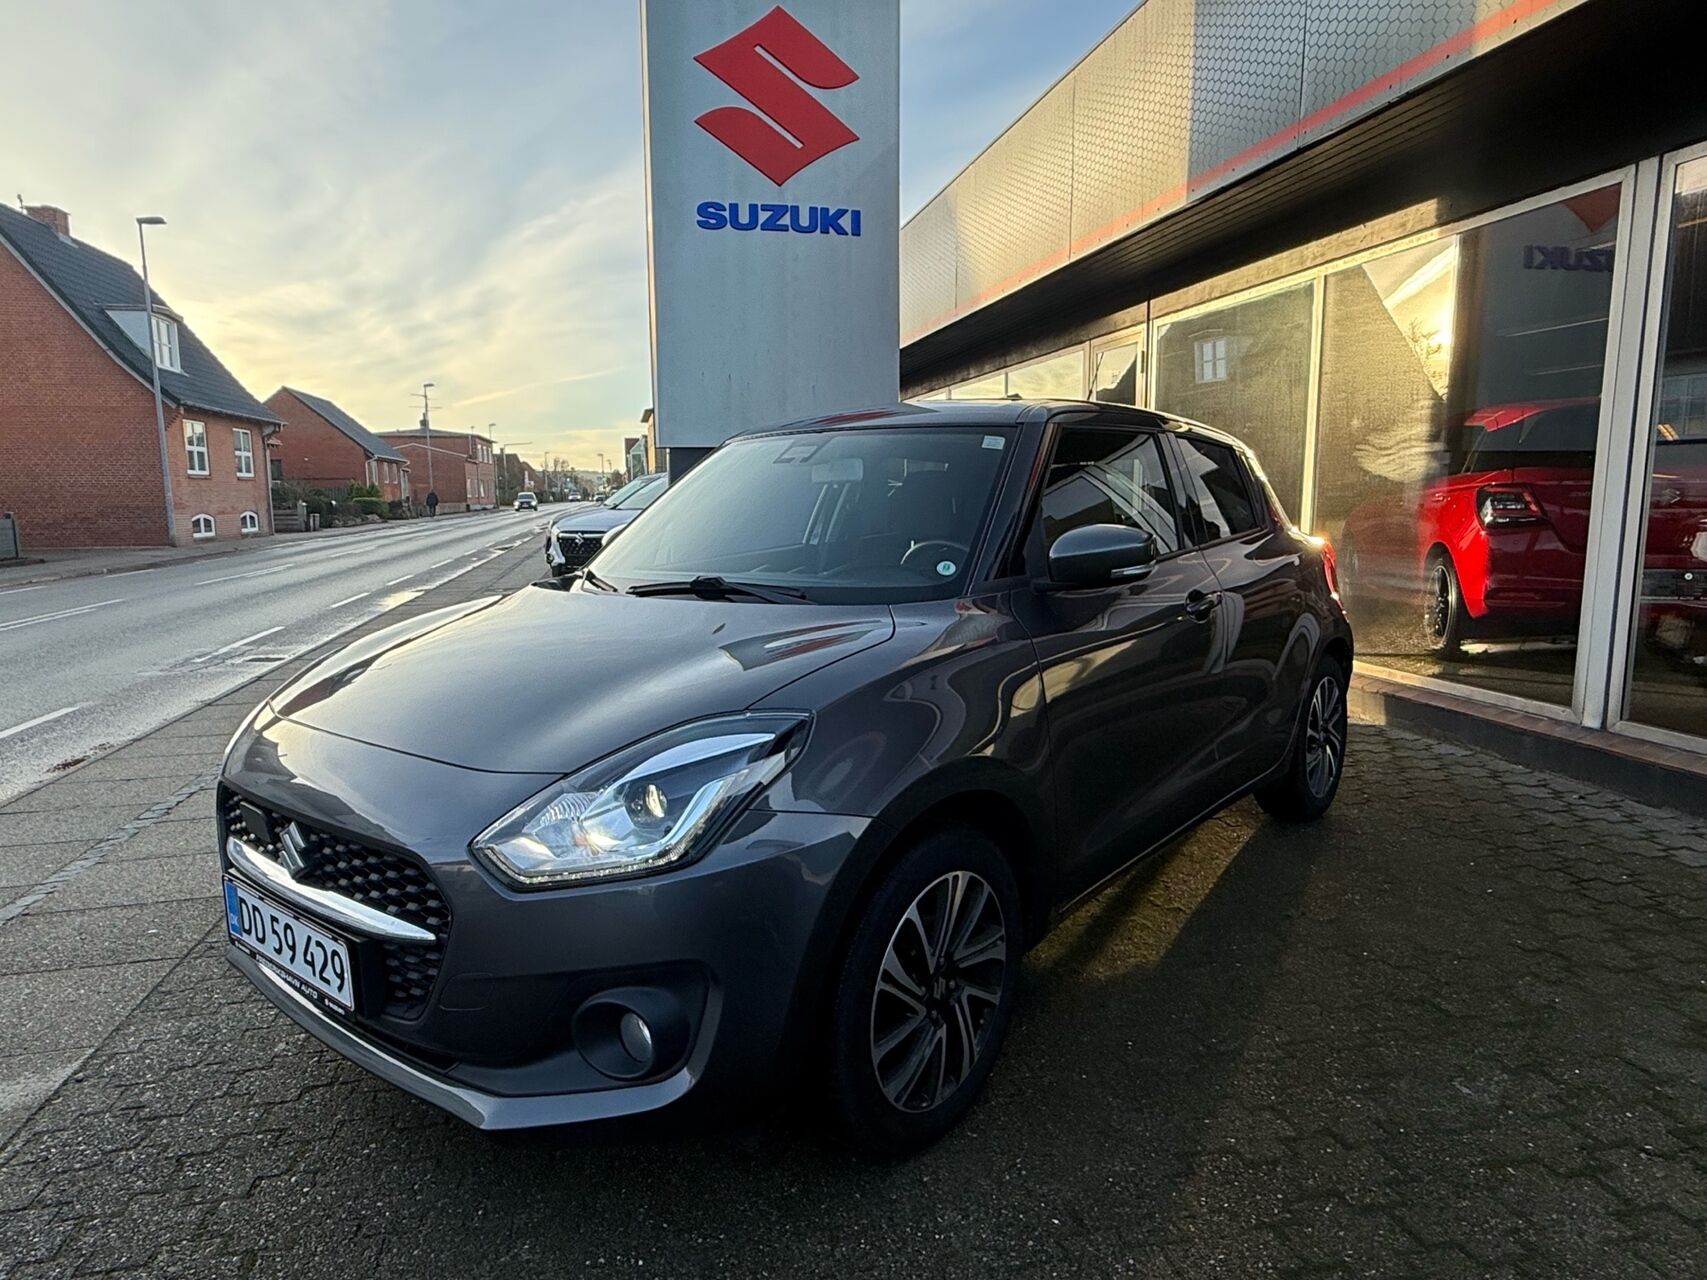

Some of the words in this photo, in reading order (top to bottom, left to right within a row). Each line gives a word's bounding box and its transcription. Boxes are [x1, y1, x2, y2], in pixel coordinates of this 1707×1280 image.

[696, 201, 861, 237] SUZUKI
[239, 896, 265, 944] DD
[270, 914, 297, 965] 59
[303, 935, 345, 993] 429
[300, 984, 318, 999] AUTO
